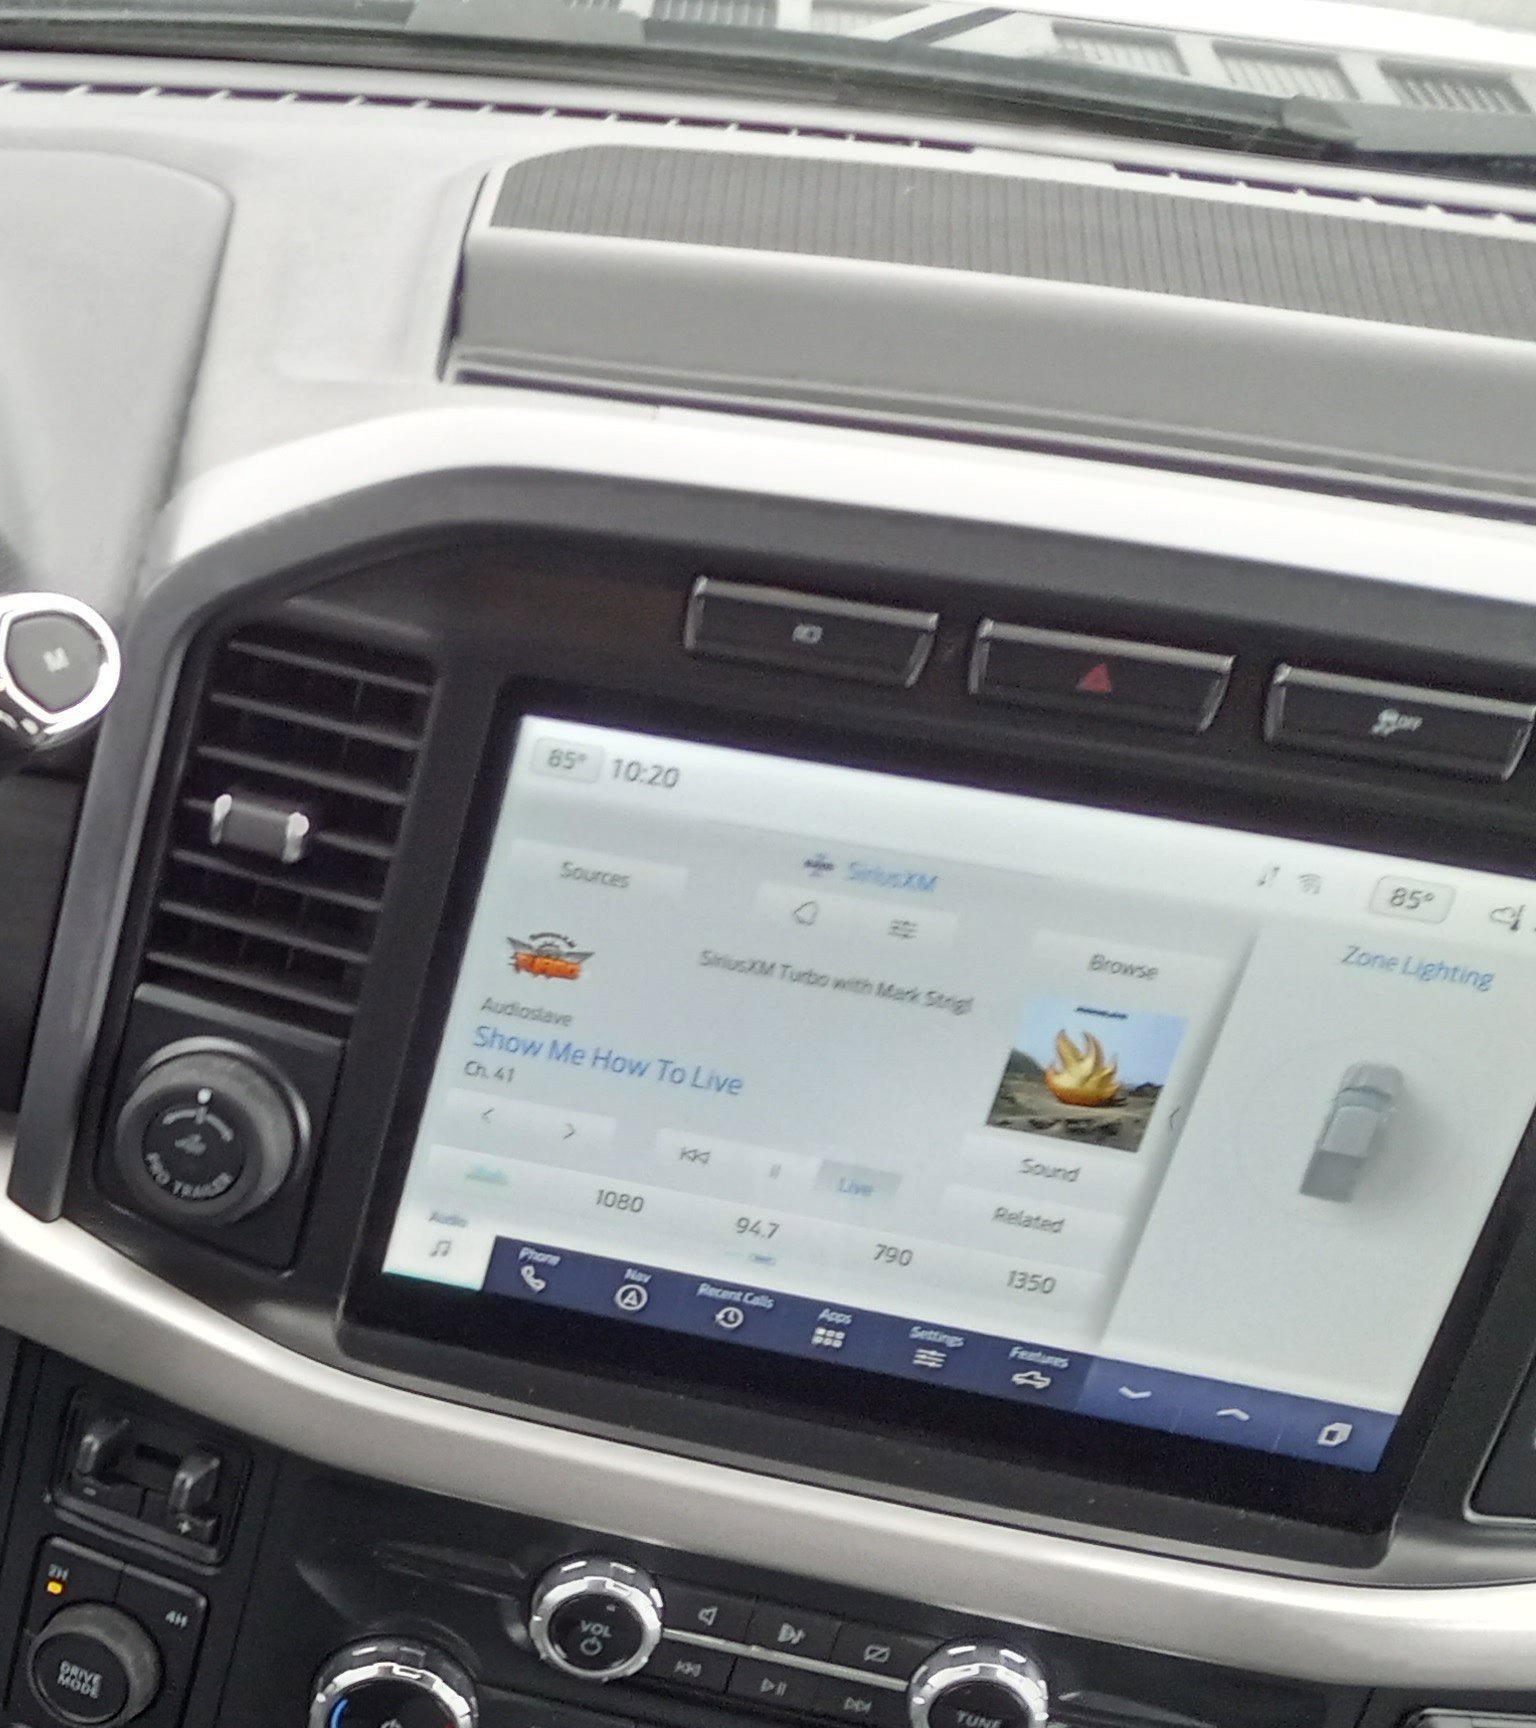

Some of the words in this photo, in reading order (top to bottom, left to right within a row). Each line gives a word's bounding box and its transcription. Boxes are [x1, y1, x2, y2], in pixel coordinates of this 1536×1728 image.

[611, 758, 681, 789] 10:20
[559, 860, 630, 890] Sources
[778, 963, 829, 988] Turbo
[1087, 953, 1160, 981] Browse
[1341, 945, 1398, 972] Zone
[1400, 956, 1496, 992] Lighting
[480, 997, 573, 1027] Audioslave
[473, 1025, 545, 1058] Show
[548, 1039, 586, 1066] Me
[591, 1047, 652, 1078] How
[657, 1058, 686, 1085] To
[691, 1065, 745, 1096] Live
[493, 1065, 515, 1084] 41
[1019, 1157, 1081, 1183] Sound
[595, 1187, 645, 1213] 1080
[734, 1216, 780, 1240] 94.7
[991, 1205, 1066, 1234] Related
[517, 1246, 562, 1268] Phone
[872, 1243, 914, 1267] 790
[624, 1268, 652, 1285] Nav
[1006, 1269, 1057, 1295] 1350
[696, 1282, 743, 1302] Recent
[743, 1291, 775, 1309] Calls
[817, 1306, 852, 1326] Apps
[909, 1325, 965, 1349] Settings
[1009, 1345, 1070, 1369] Features
[165, 1609, 188, 1629] 4H
[579, 1619, 612, 1639] VOL
[57, 1673, 100, 1699] MODE
[59, 1660, 102, 1686] DRIVE
